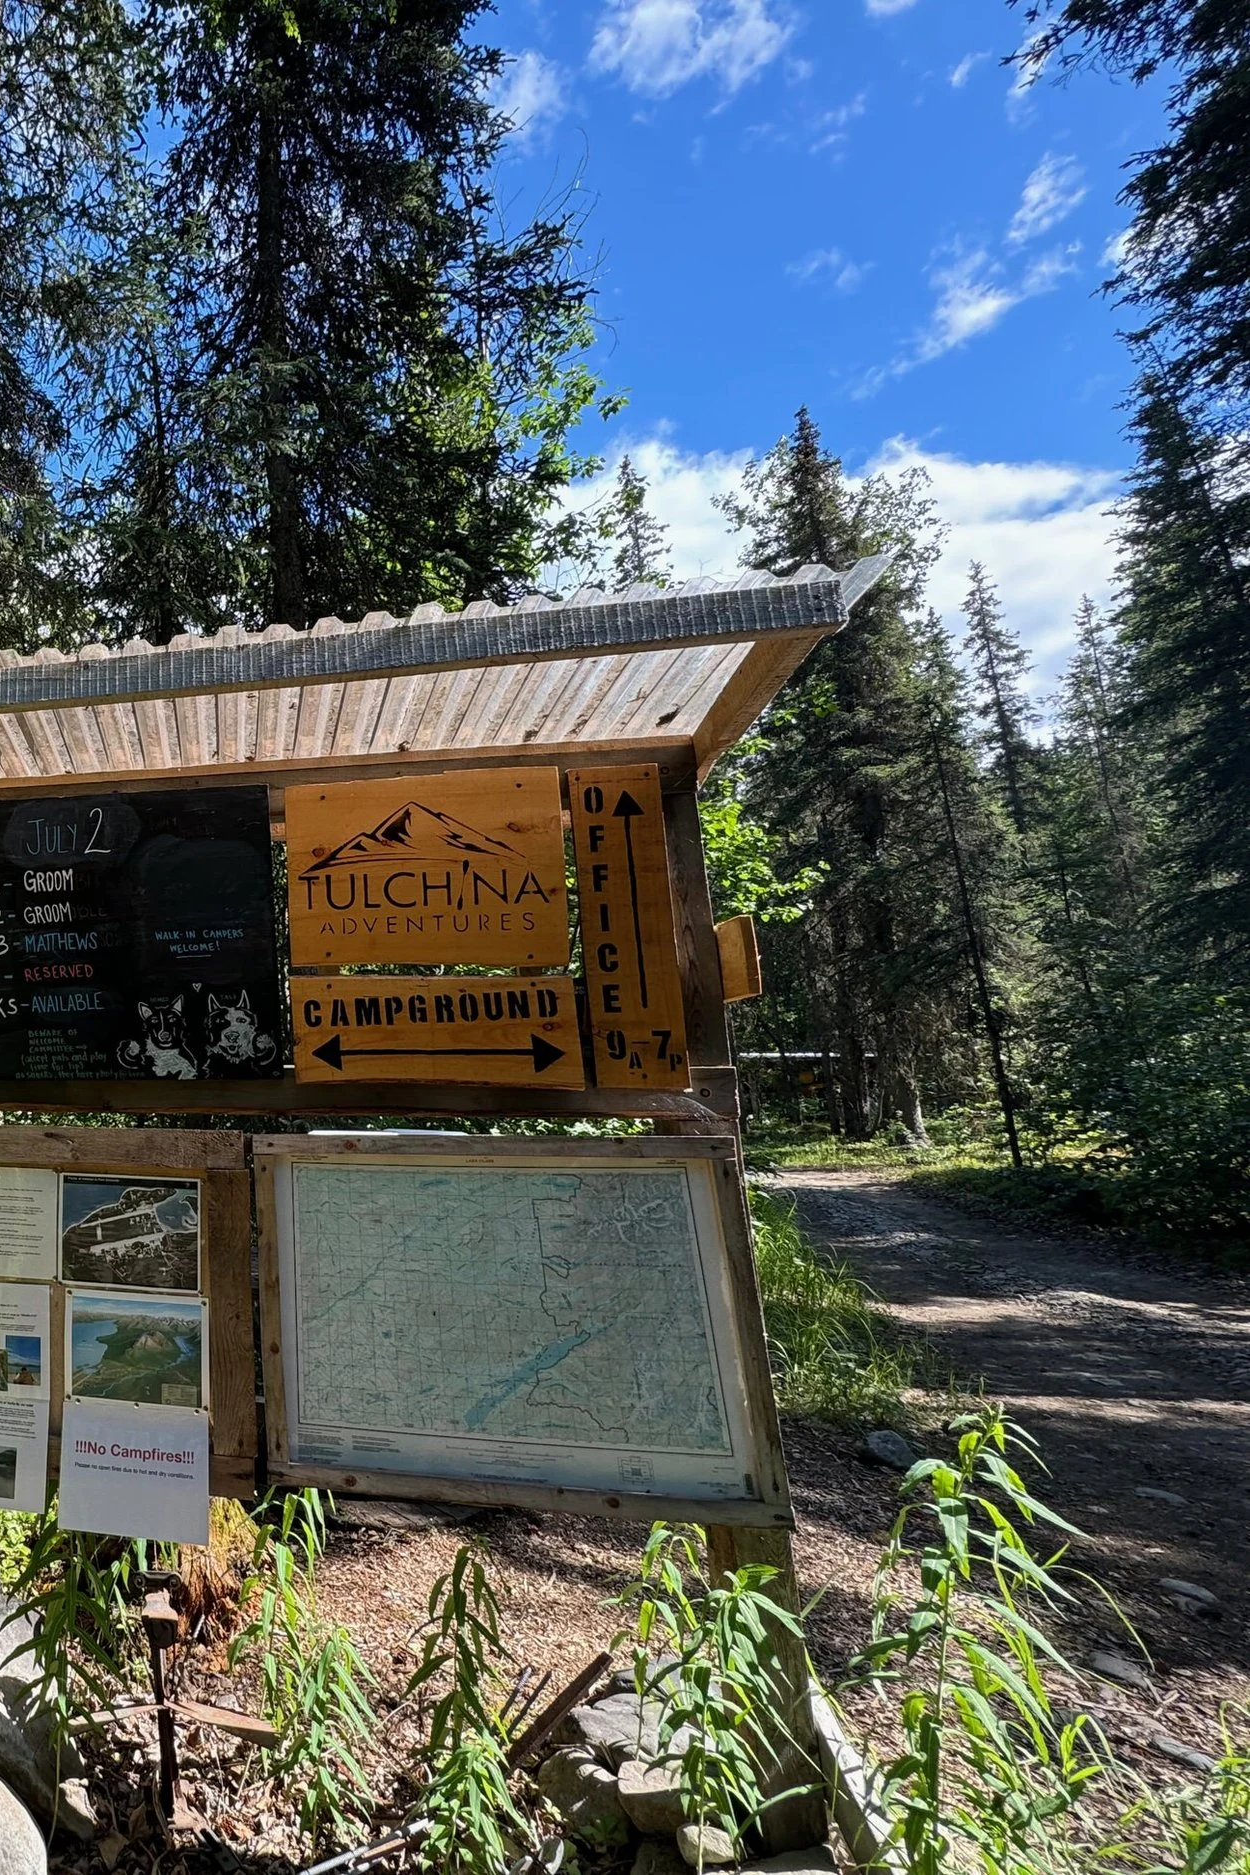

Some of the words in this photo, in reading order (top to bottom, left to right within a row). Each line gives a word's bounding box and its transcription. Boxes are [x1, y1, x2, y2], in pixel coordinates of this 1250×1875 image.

[26, 818, 77, 855] JULY
[84, 807, 111, 854] 2
[23, 868, 74, 893] GROOM
[297, 859, 550, 910] TULCHINA
[584, 786, 622, 1013] OFFICE
[23, 901, 73, 924] GROOM
[320, 912, 535, 935] ADVENTURES
[24, 932, 98, 953] MATTHEWS
[203, 928, 244, 939] CAMPERS
[170, 940, 221, 953] WELCOME!
[24, 963, 94, 982] RESERVED
[31, 991, 105, 1013] AVAILABLE
[303, 989, 558, 1028] CAMPGROUND
[71, 1051, 88, 1061] and
[75, 1440, 106, 1455] !!!No
[110, 1444, 195, 1464] Campfires!!!
[159, 1470, 167, 1478] dry
